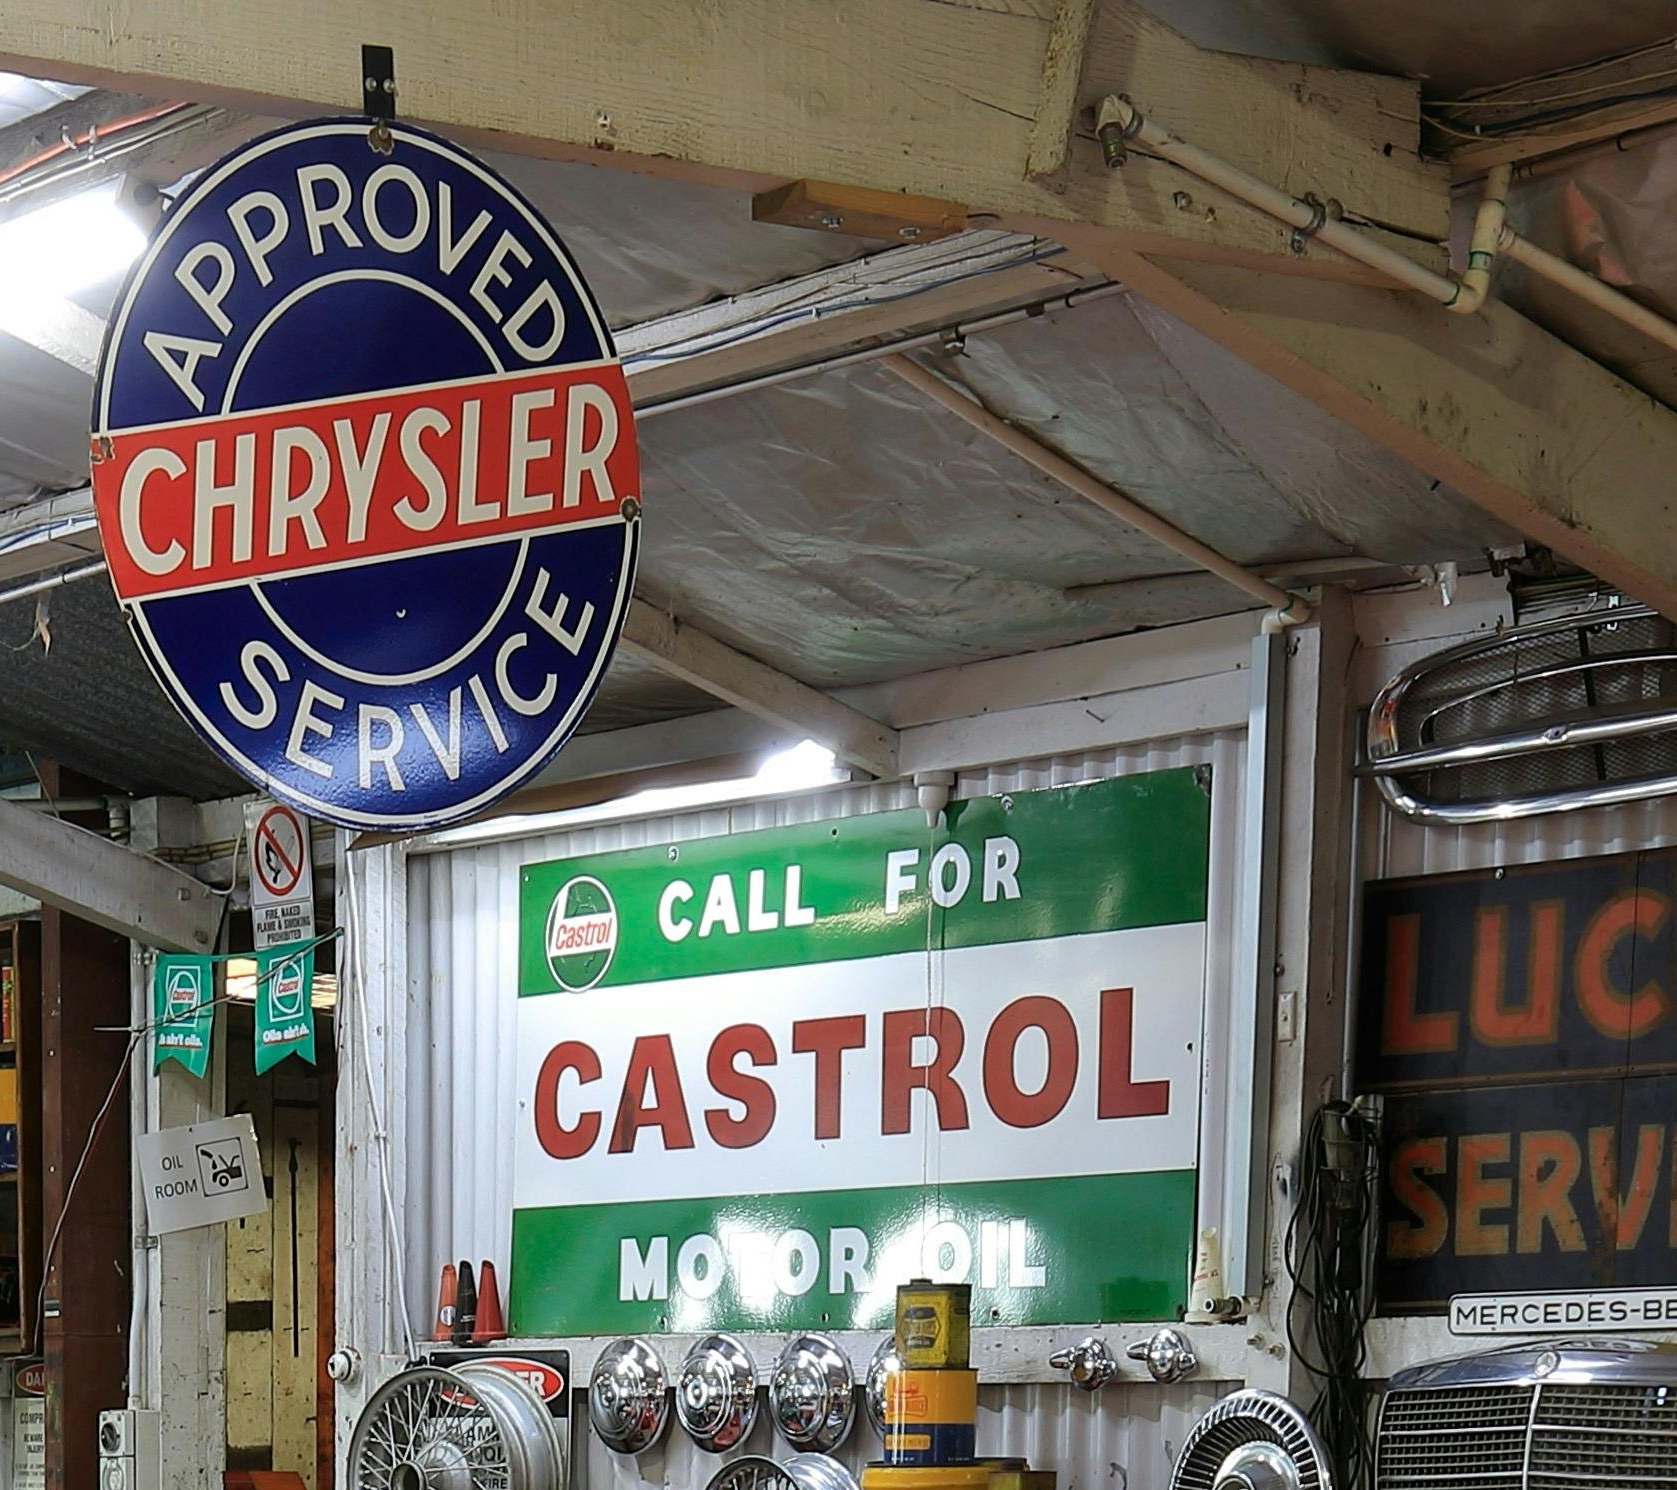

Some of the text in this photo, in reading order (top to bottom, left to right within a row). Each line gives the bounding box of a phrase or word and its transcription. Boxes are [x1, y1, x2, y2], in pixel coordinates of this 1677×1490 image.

[142, 162, 567, 413] APPROVED
[119, 383, 619, 575] CHRYSLER
[219, 566, 595, 793] SERVICE
[554, 917, 613, 957] Castrol
[658, 835, 1022, 943] CALL FOR
[534, 987, 1172, 1162] CASTROL
[154, 1179, 199, 1200] ROOM
[161, 1154, 183, 1174] OIL
[618, 1219, 1045, 1303] MOTOR OIL
